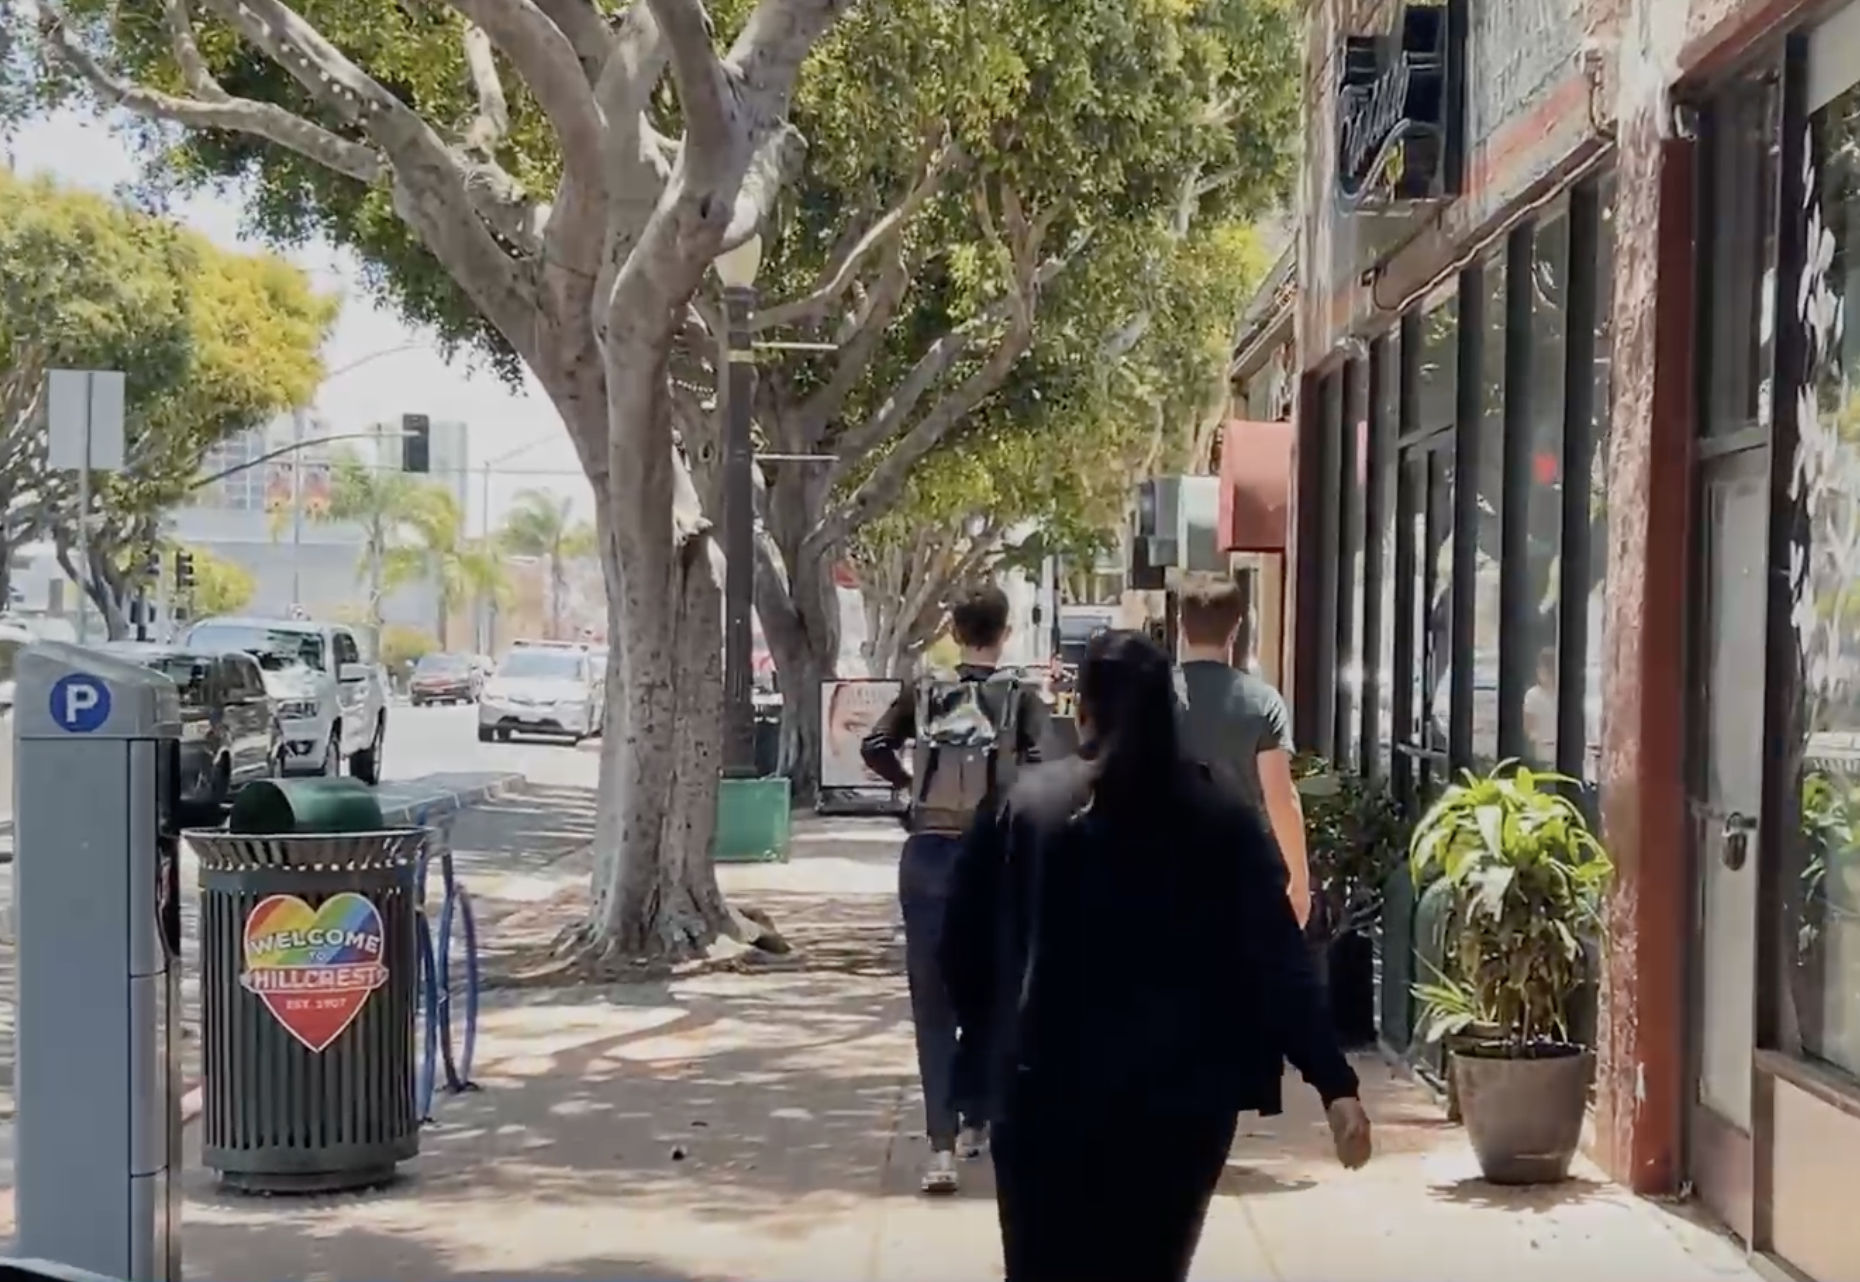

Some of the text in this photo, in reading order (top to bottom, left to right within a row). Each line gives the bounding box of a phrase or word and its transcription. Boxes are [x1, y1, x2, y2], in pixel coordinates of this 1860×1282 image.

[66, 683, 98, 723] P
[250, 928, 380, 954] WELCOME
[308, 951, 325, 961] TO
[254, 966, 378, 989] HILLCREST
